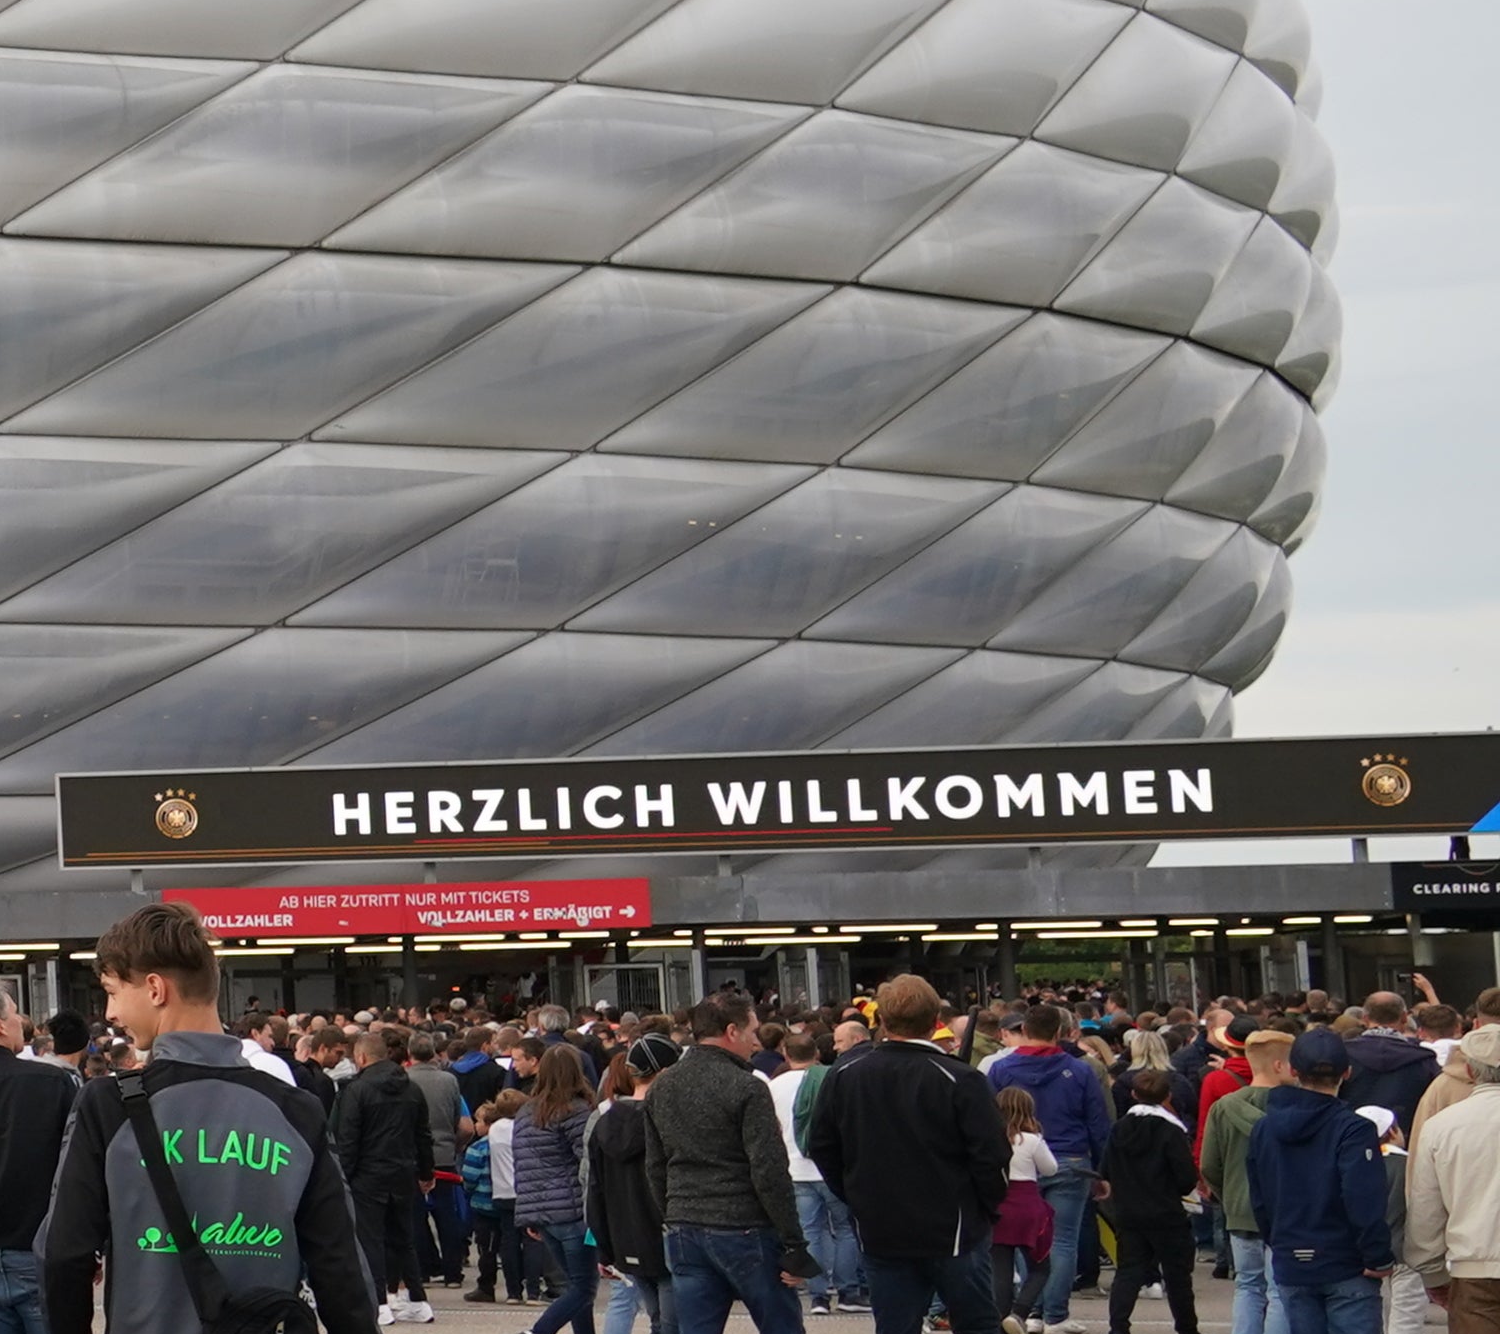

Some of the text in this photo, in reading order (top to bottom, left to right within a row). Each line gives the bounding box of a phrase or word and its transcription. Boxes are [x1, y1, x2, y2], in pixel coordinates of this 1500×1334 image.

[332, 768, 1214, 835] HERZLICH WILLKOMMEN
[1412, 882, 1490, 895] CLEARING
[279, 889, 530, 909] AB HIER ZUTRITT NUR MIT TICKETS
[417, 908, 514, 924] VOLLZAHLER
[198, 1128, 292, 1175] LAUF
